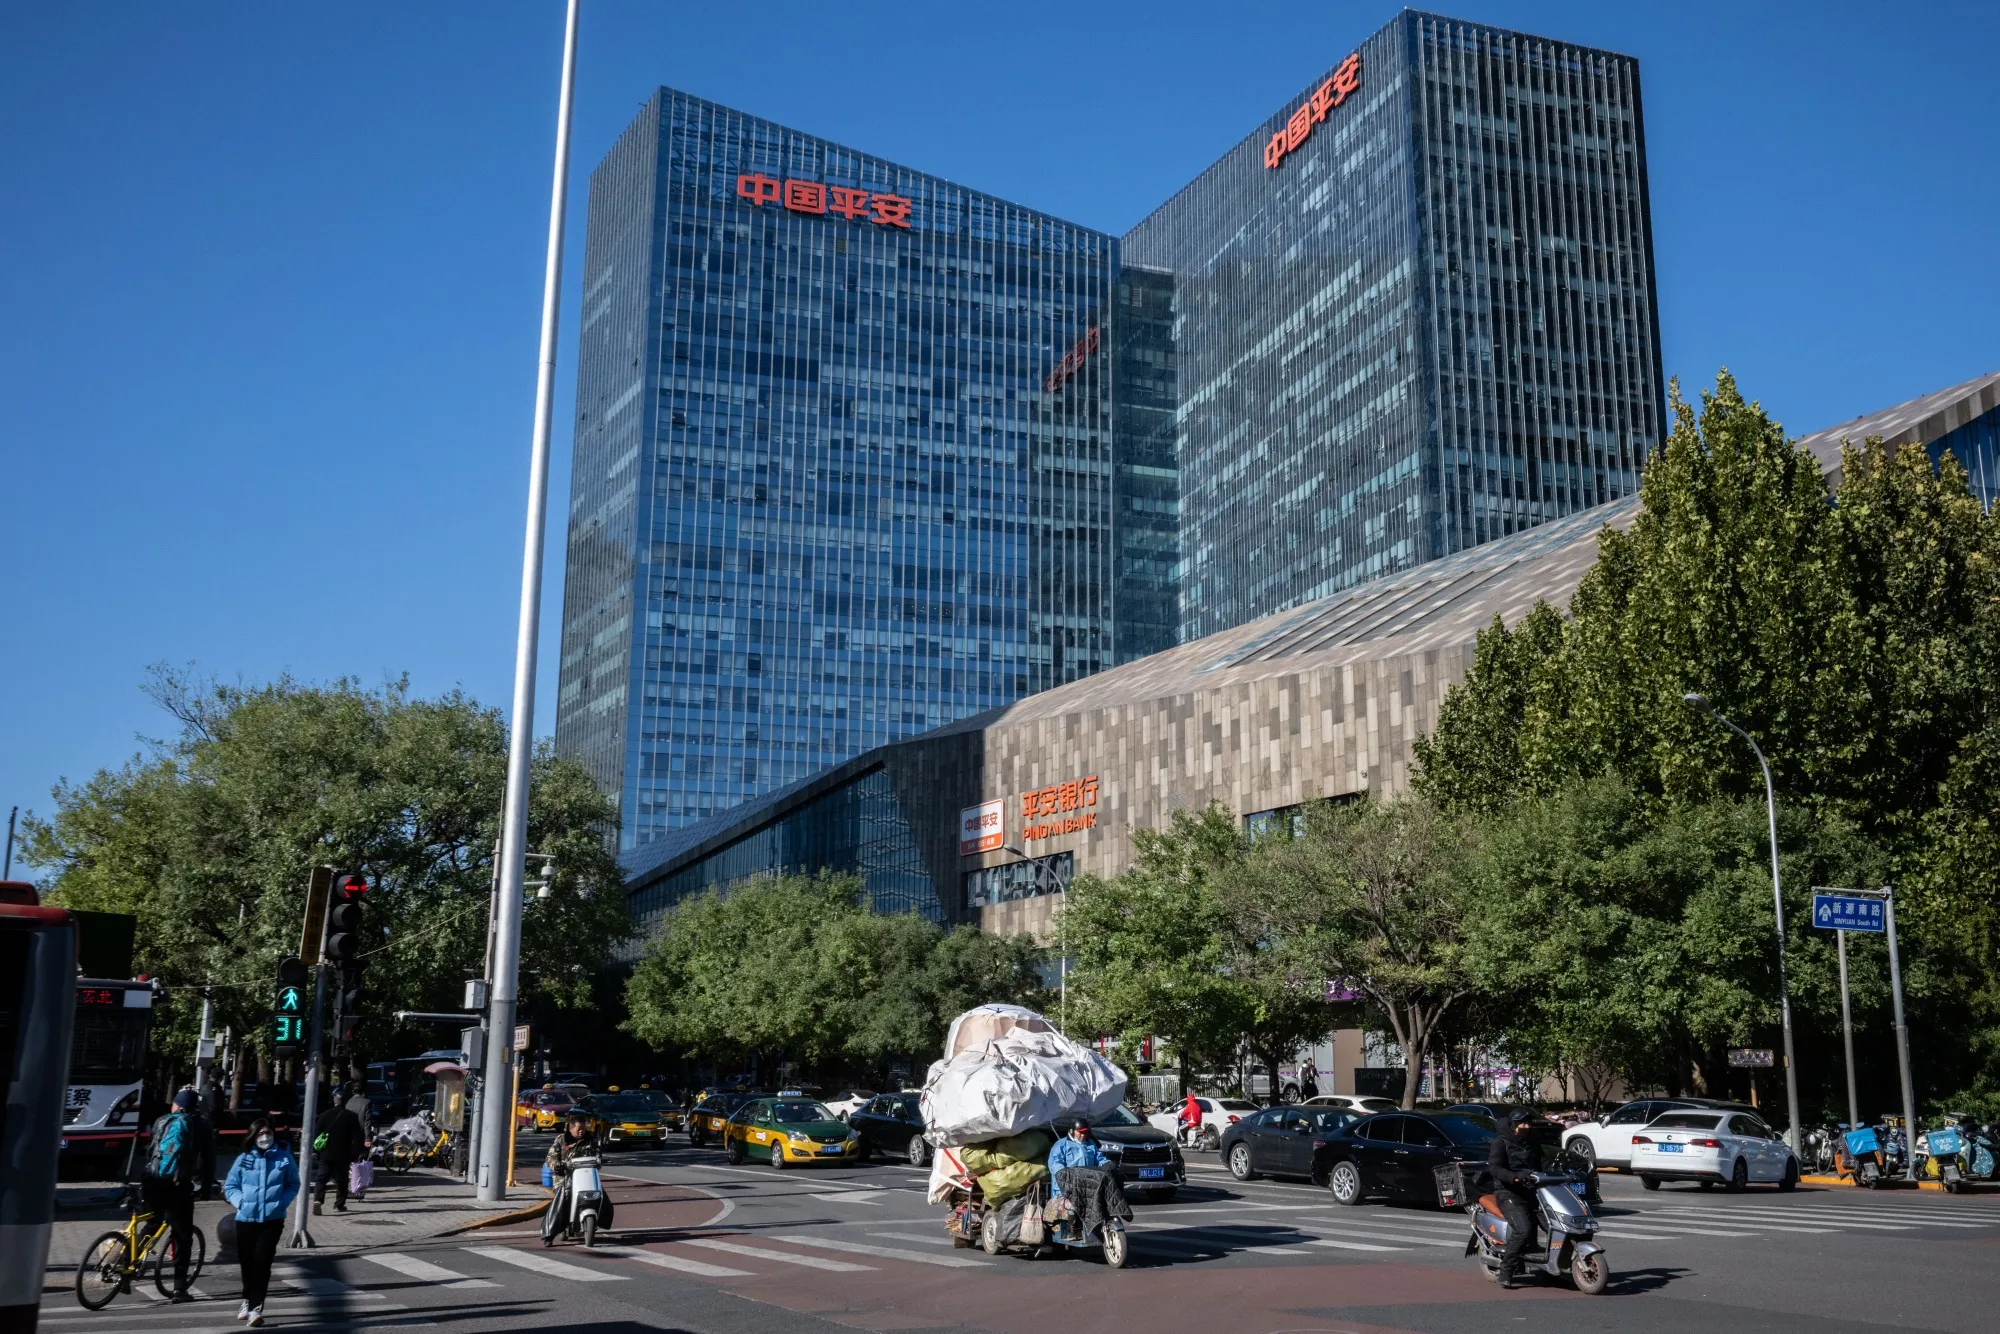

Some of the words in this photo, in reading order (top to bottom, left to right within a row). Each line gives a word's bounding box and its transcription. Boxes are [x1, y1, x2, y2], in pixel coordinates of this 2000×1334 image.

[1264, 53, 1360, 169] 中国平安
[737, 173, 913, 229] 中国平安
[1021, 775, 1099, 820] 平安银行
[965, 812, 998, 833] 中国平安
[1065, 812, 1097, 833] BANK
[1832, 902, 1880, 916] 新源南路
[276, 1017, 302, 1041] 31
